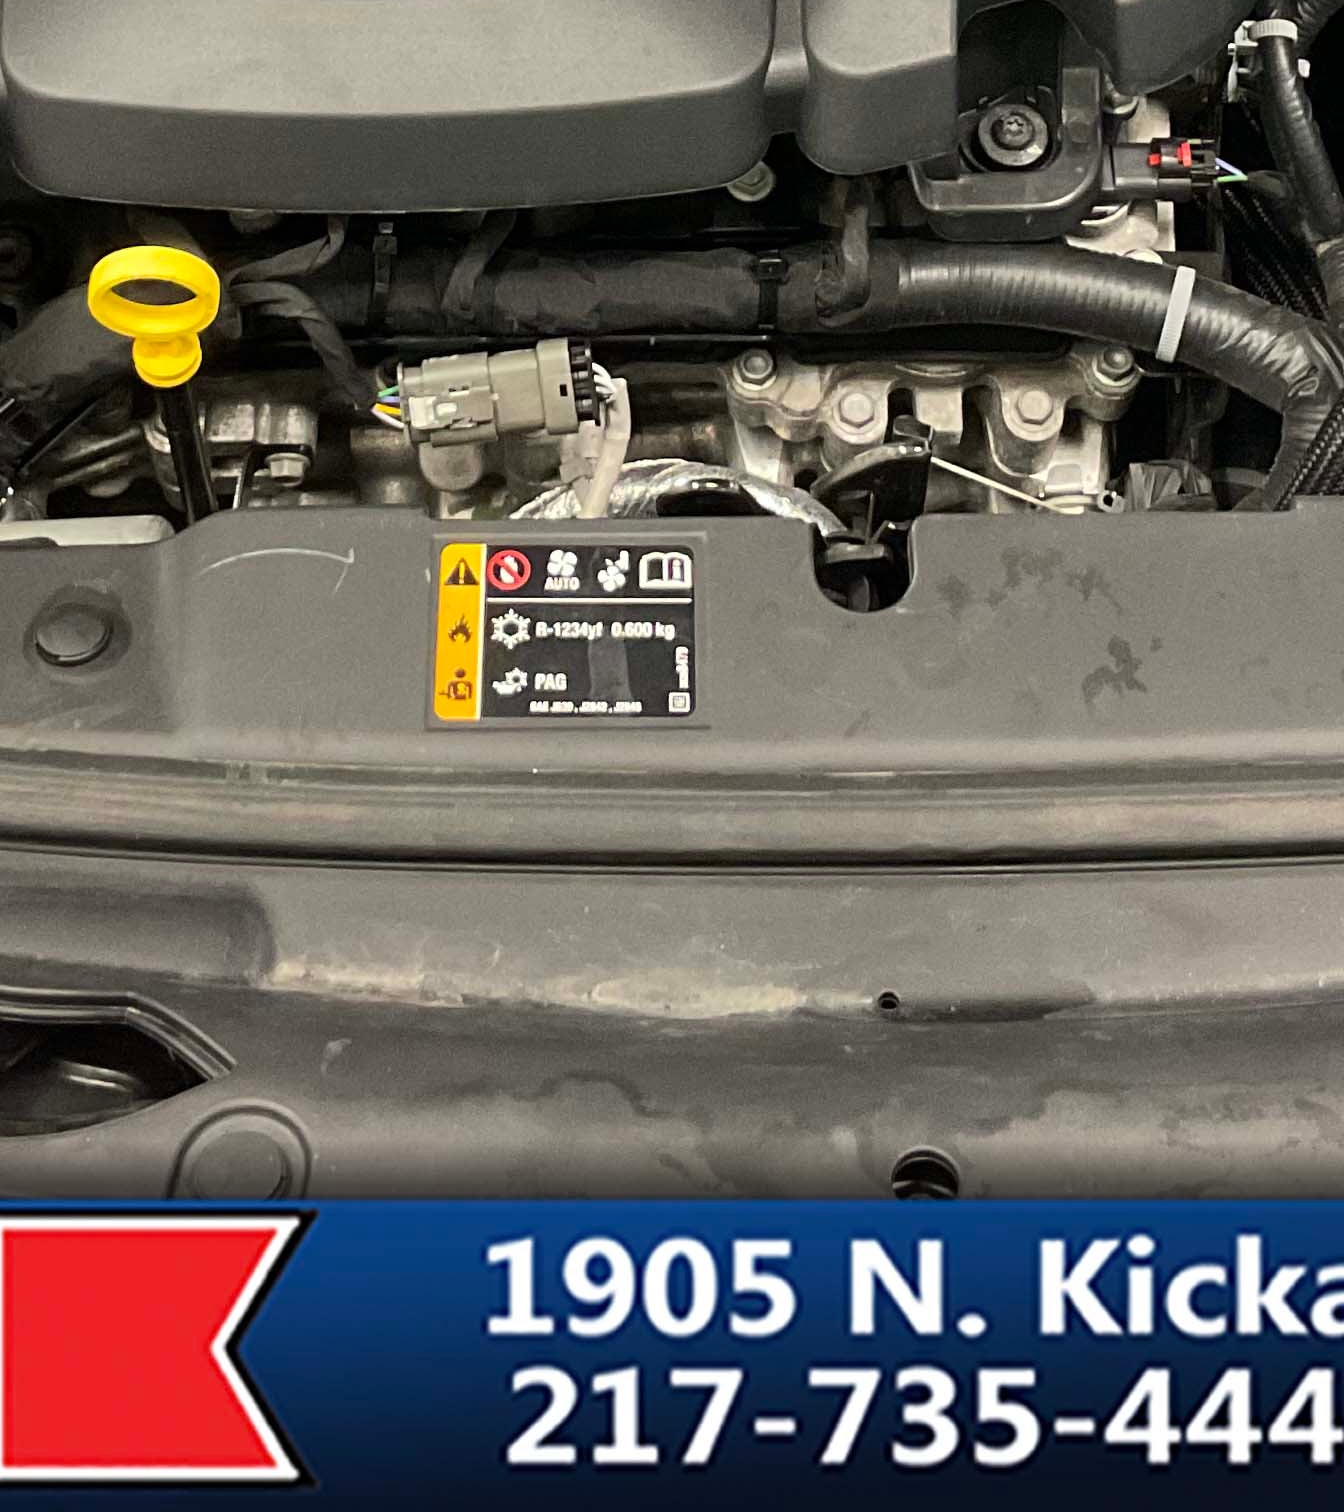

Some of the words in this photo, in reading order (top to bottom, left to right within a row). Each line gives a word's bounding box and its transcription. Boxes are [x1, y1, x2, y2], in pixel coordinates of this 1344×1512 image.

[544, 576, 580, 591] AUTO
[610, 621, 653, 638] 0.600
[655, 621, 676, 641] kg
[535, 673, 567, 691] PAG
